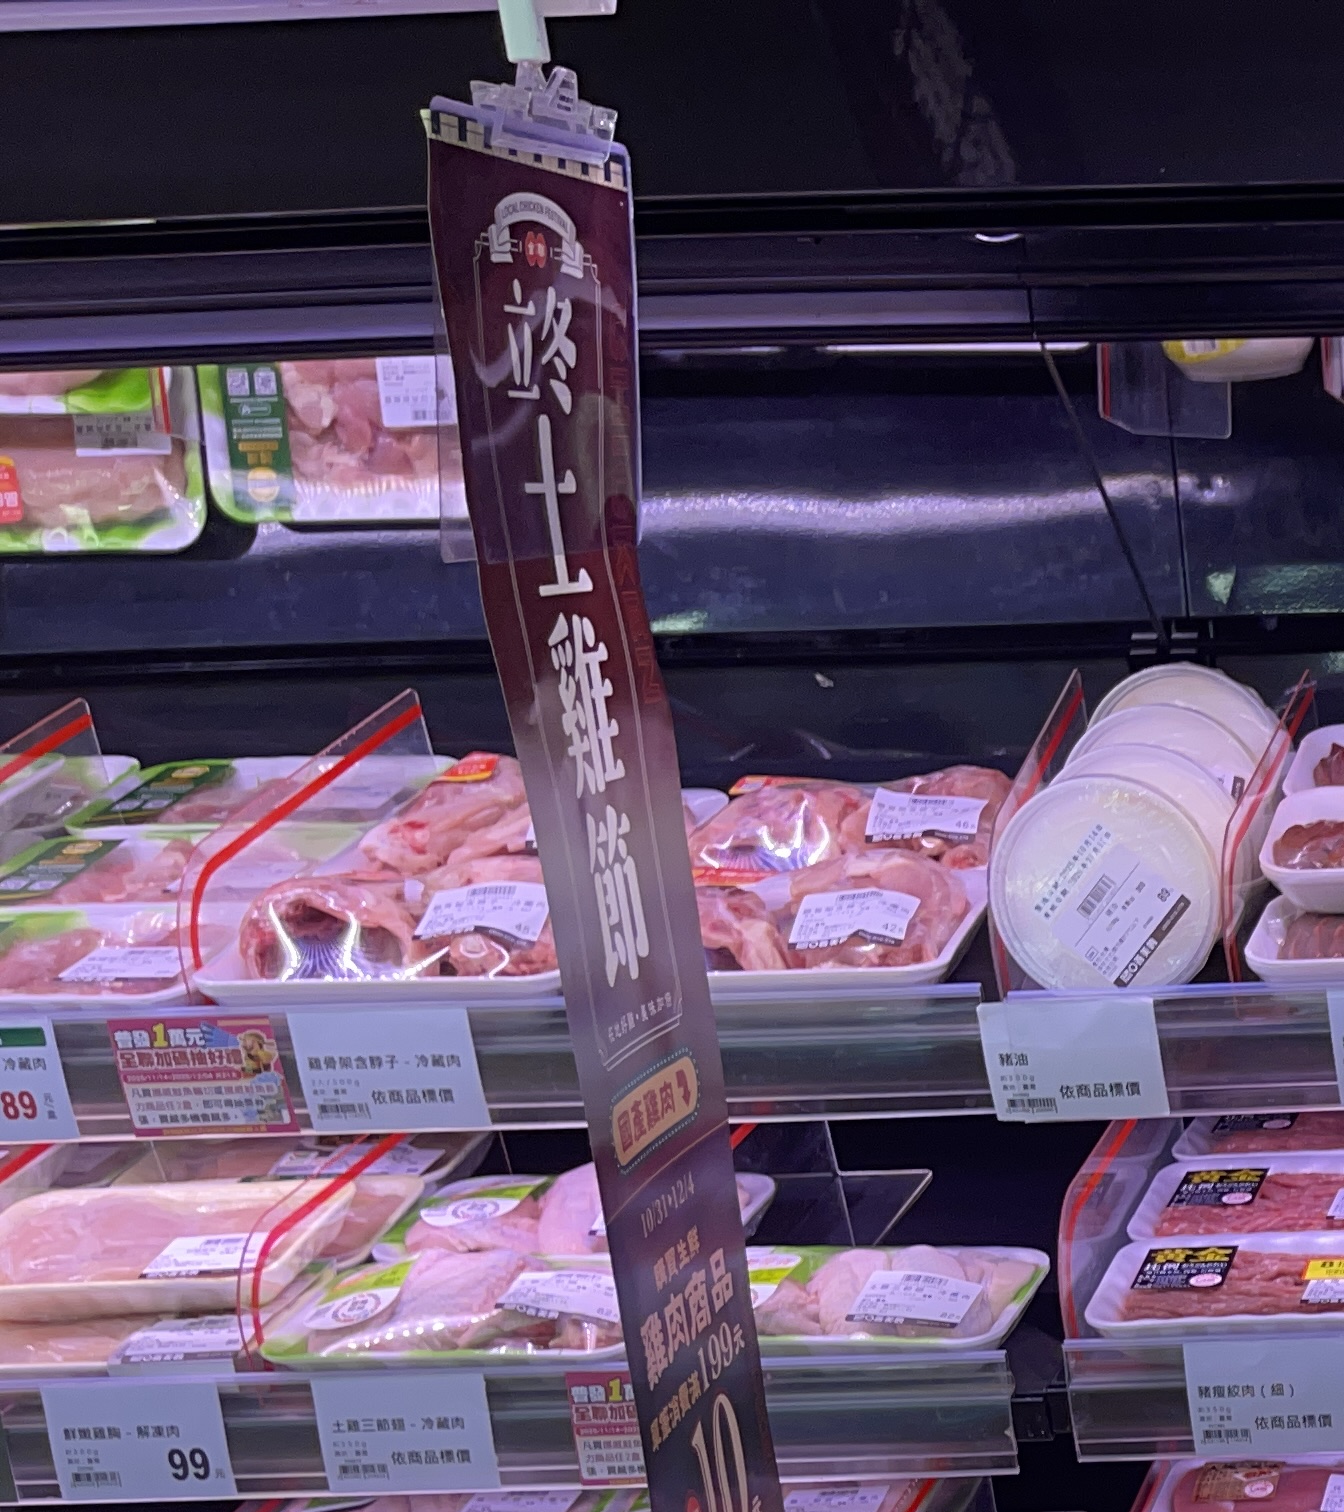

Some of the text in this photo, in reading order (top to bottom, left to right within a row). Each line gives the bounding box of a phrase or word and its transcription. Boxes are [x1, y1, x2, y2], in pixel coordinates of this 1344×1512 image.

[416, 1054, 461, 1068] 冷藏肉
[998, 1053, 1029, 1067] 豬油
[372, 1088, 455, 1105] 依商品標價
[1059, 1081, 1141, 1098] 依商品標價
[2, 1091, 37, 1119] 89
[617, 1081, 676, 1153] 國產雞肉
[653, 1225, 700, 1291] 購買生鮮
[640, 1248, 733, 1391] 雞肉商品
[700, 1322, 733, 1393] 199
[733, 1323, 745, 1348] 元
[332, 1416, 465, 1433] 土雞三節翅 冷藏肉
[1254, 1413, 1333, 1431] 依商品標價
[64, 1425, 180, 1440] 鮮嫩雞胸 解凍肉
[168, 1448, 210, 1480] 99
[391, 1449, 472, 1466] 依商品標價
